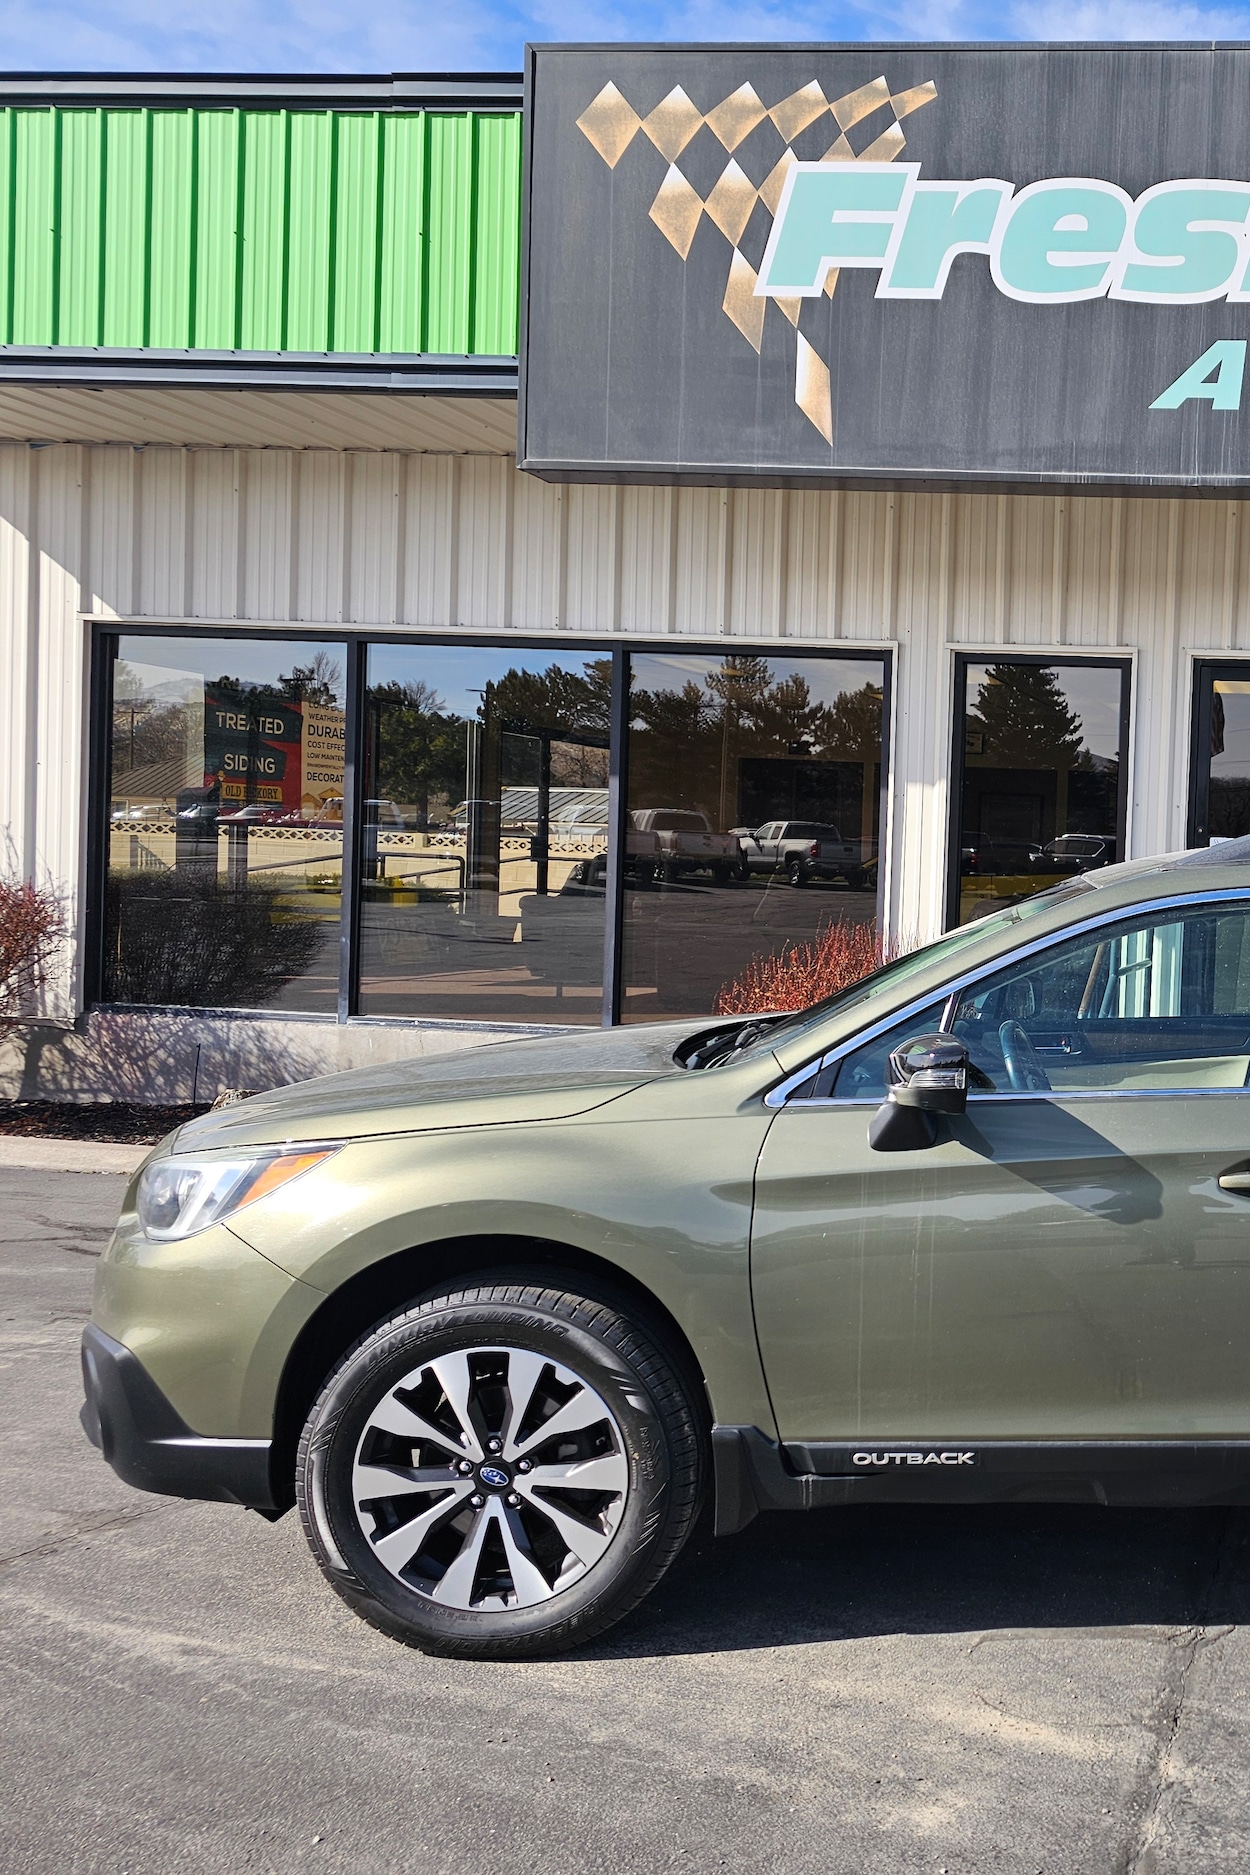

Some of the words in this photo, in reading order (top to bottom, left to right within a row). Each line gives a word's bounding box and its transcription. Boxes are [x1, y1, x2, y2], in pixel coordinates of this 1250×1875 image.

[215, 711, 285, 735] TREATED
[308, 712, 339, 724] WEATHER
[307, 740, 326, 750] COST
[306, 751, 321, 759] LOW
[223, 753, 276, 774] SIDNG
[225, 784, 242, 797] OLD
[244, 786, 279, 800] HKORY
[852, 1452, 976, 1466] OUTBACK
